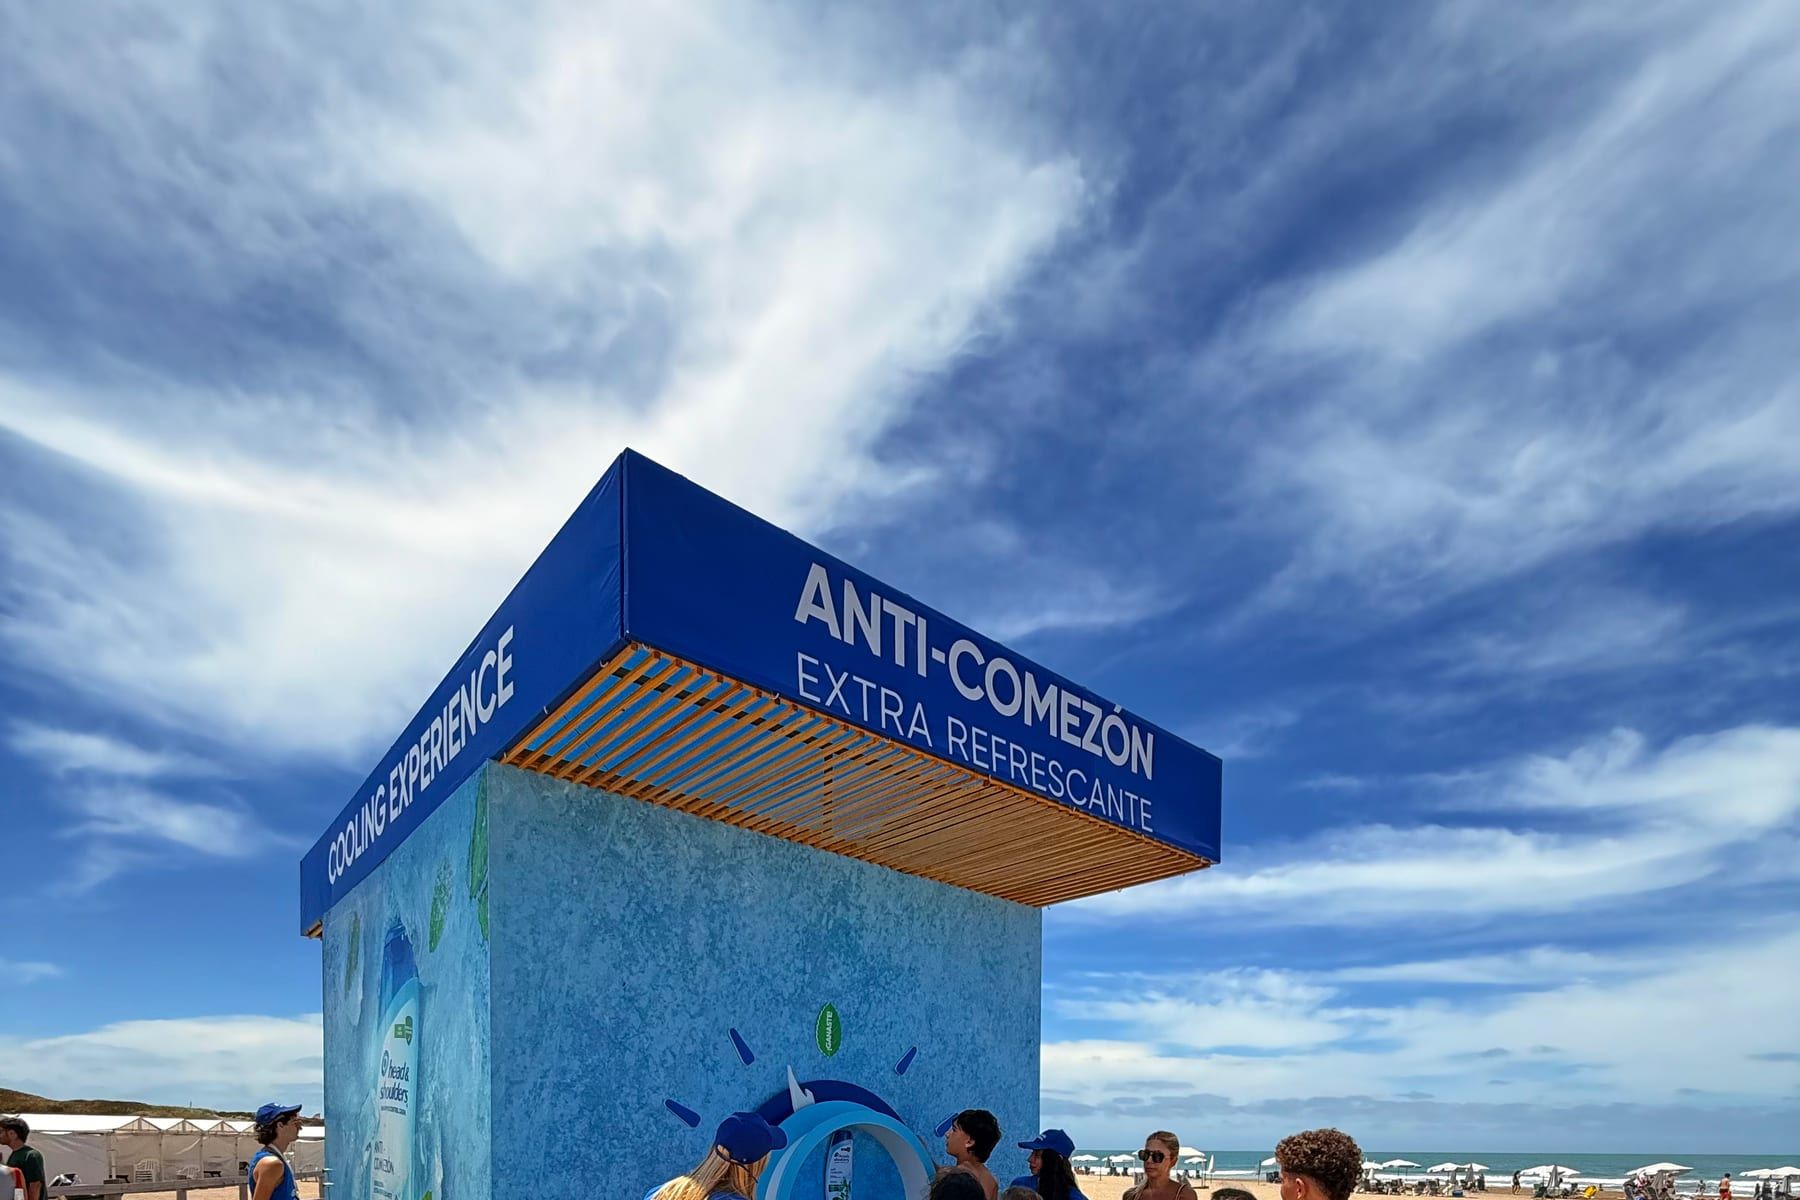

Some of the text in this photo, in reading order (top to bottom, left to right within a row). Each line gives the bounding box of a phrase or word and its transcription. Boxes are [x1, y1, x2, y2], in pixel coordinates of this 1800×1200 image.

[328, 625, 514, 885] COOLING EXPERIENCE
[795, 562, 1154, 781] ANTI-COMEZÓN
[797, 651, 1154, 833] EXTRA REFRESCANTE
